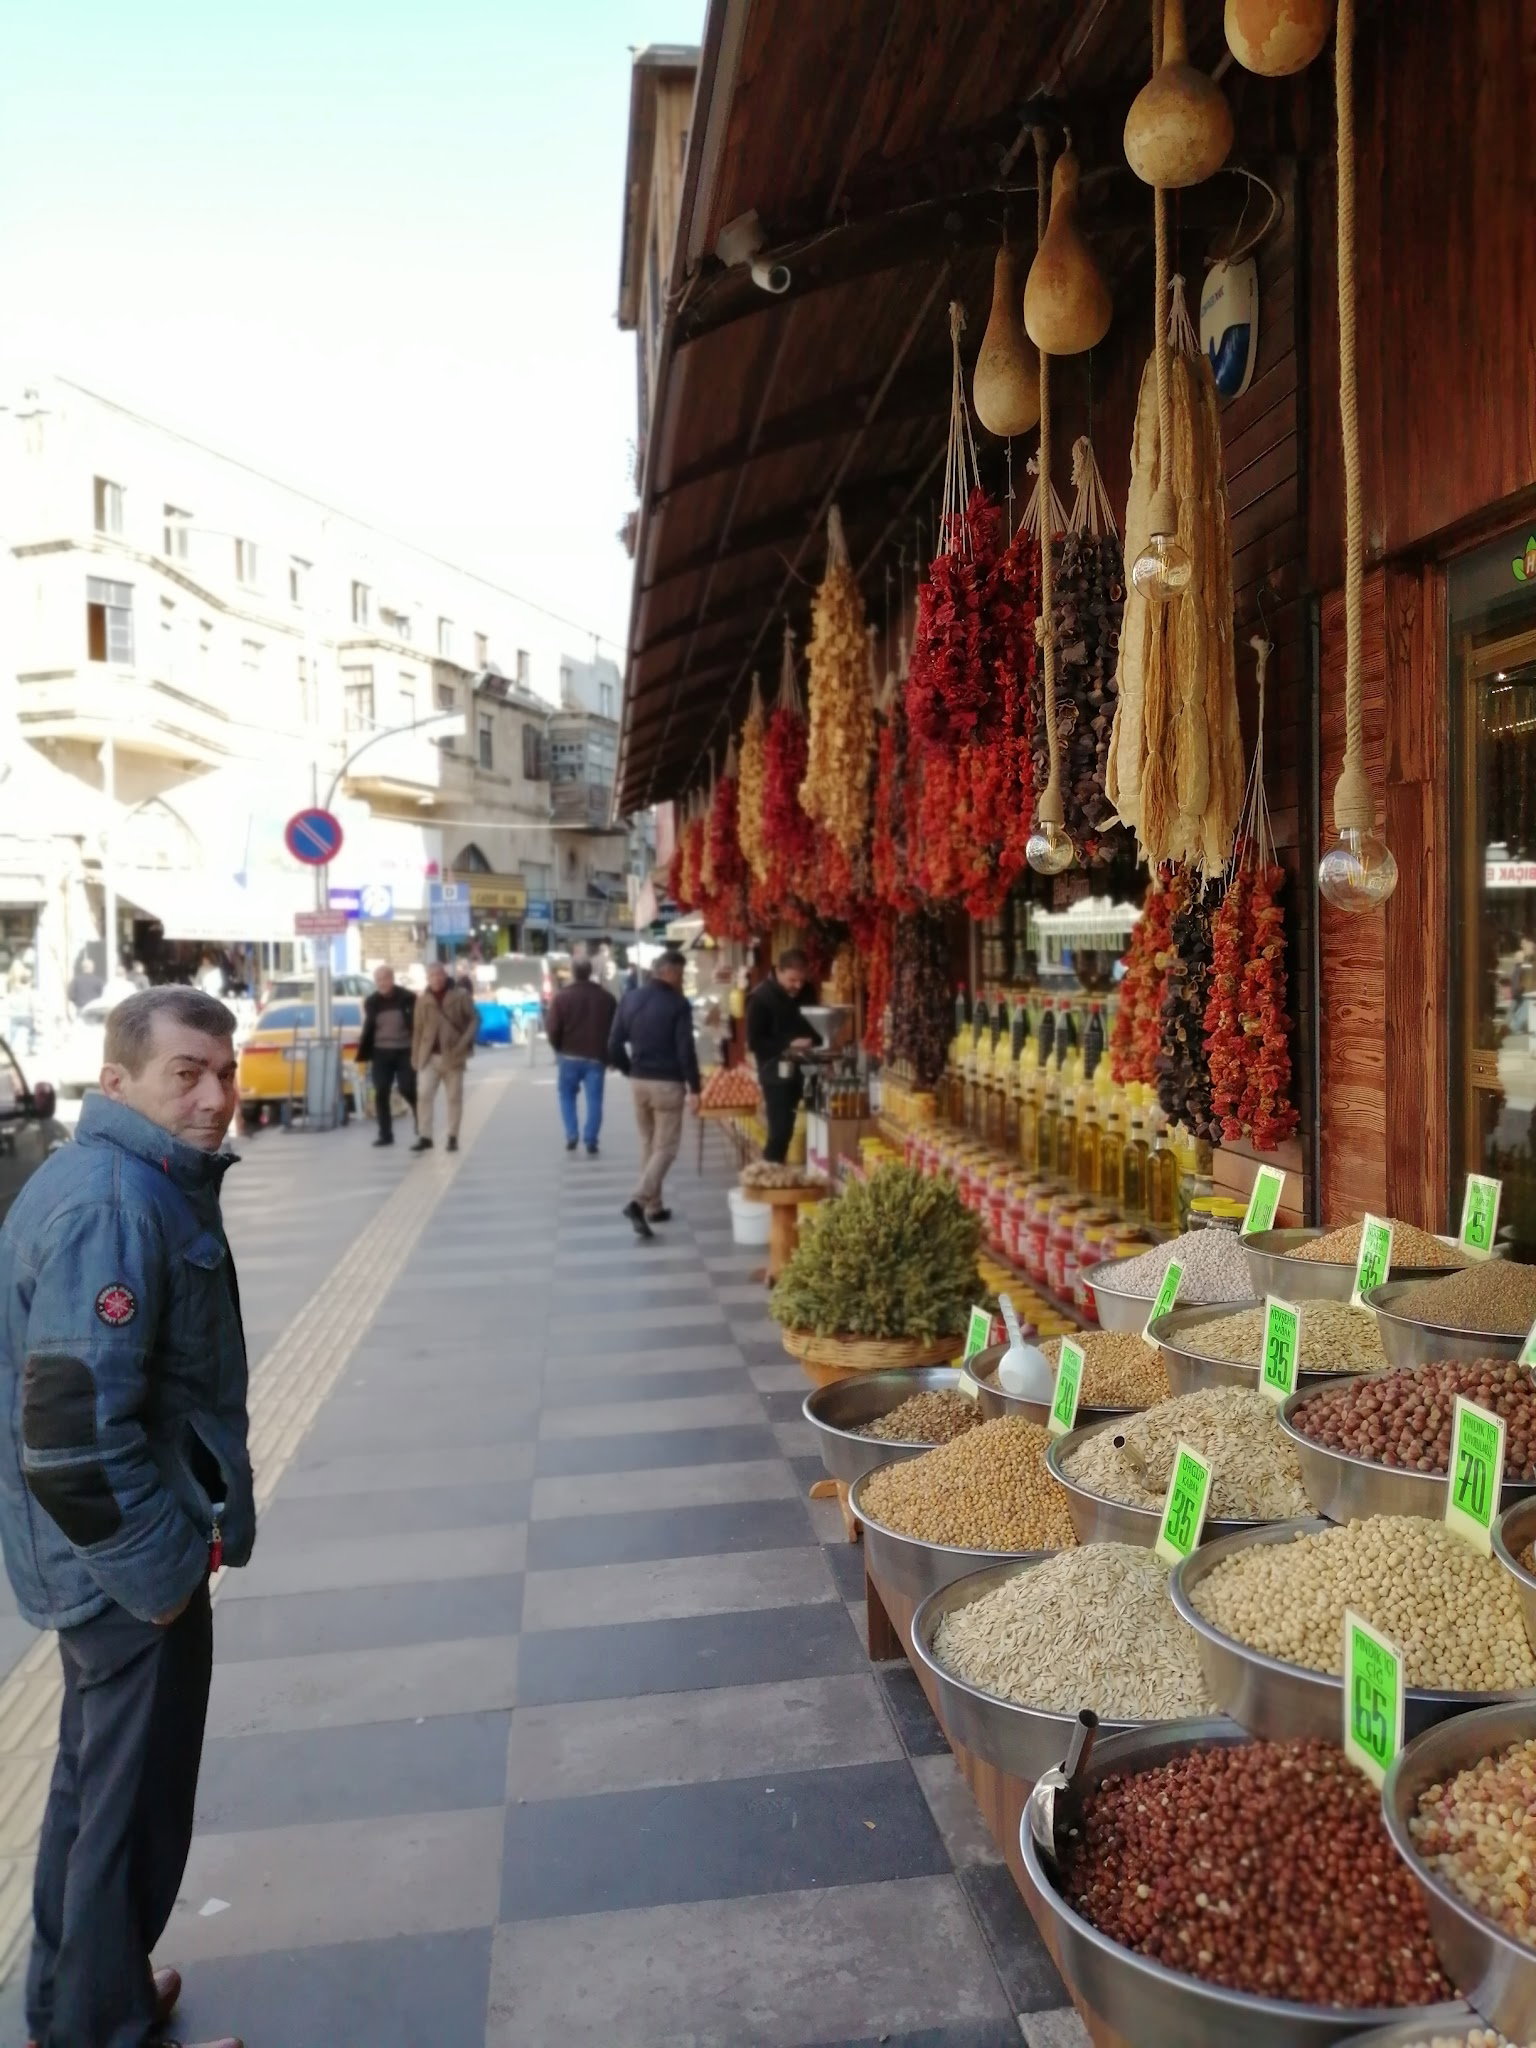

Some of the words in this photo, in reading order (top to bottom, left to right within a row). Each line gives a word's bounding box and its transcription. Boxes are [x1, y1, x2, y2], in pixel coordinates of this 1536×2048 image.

[1471, 1211, 1486, 1243] 5
[1267, 1336, 1290, 1386] 35
[1056, 1376, 1075, 1421] 20
[1458, 1449, 1487, 1516] 70
[1167, 1488, 1195, 1547] 35
[1355, 1673, 1387, 1759] 65
